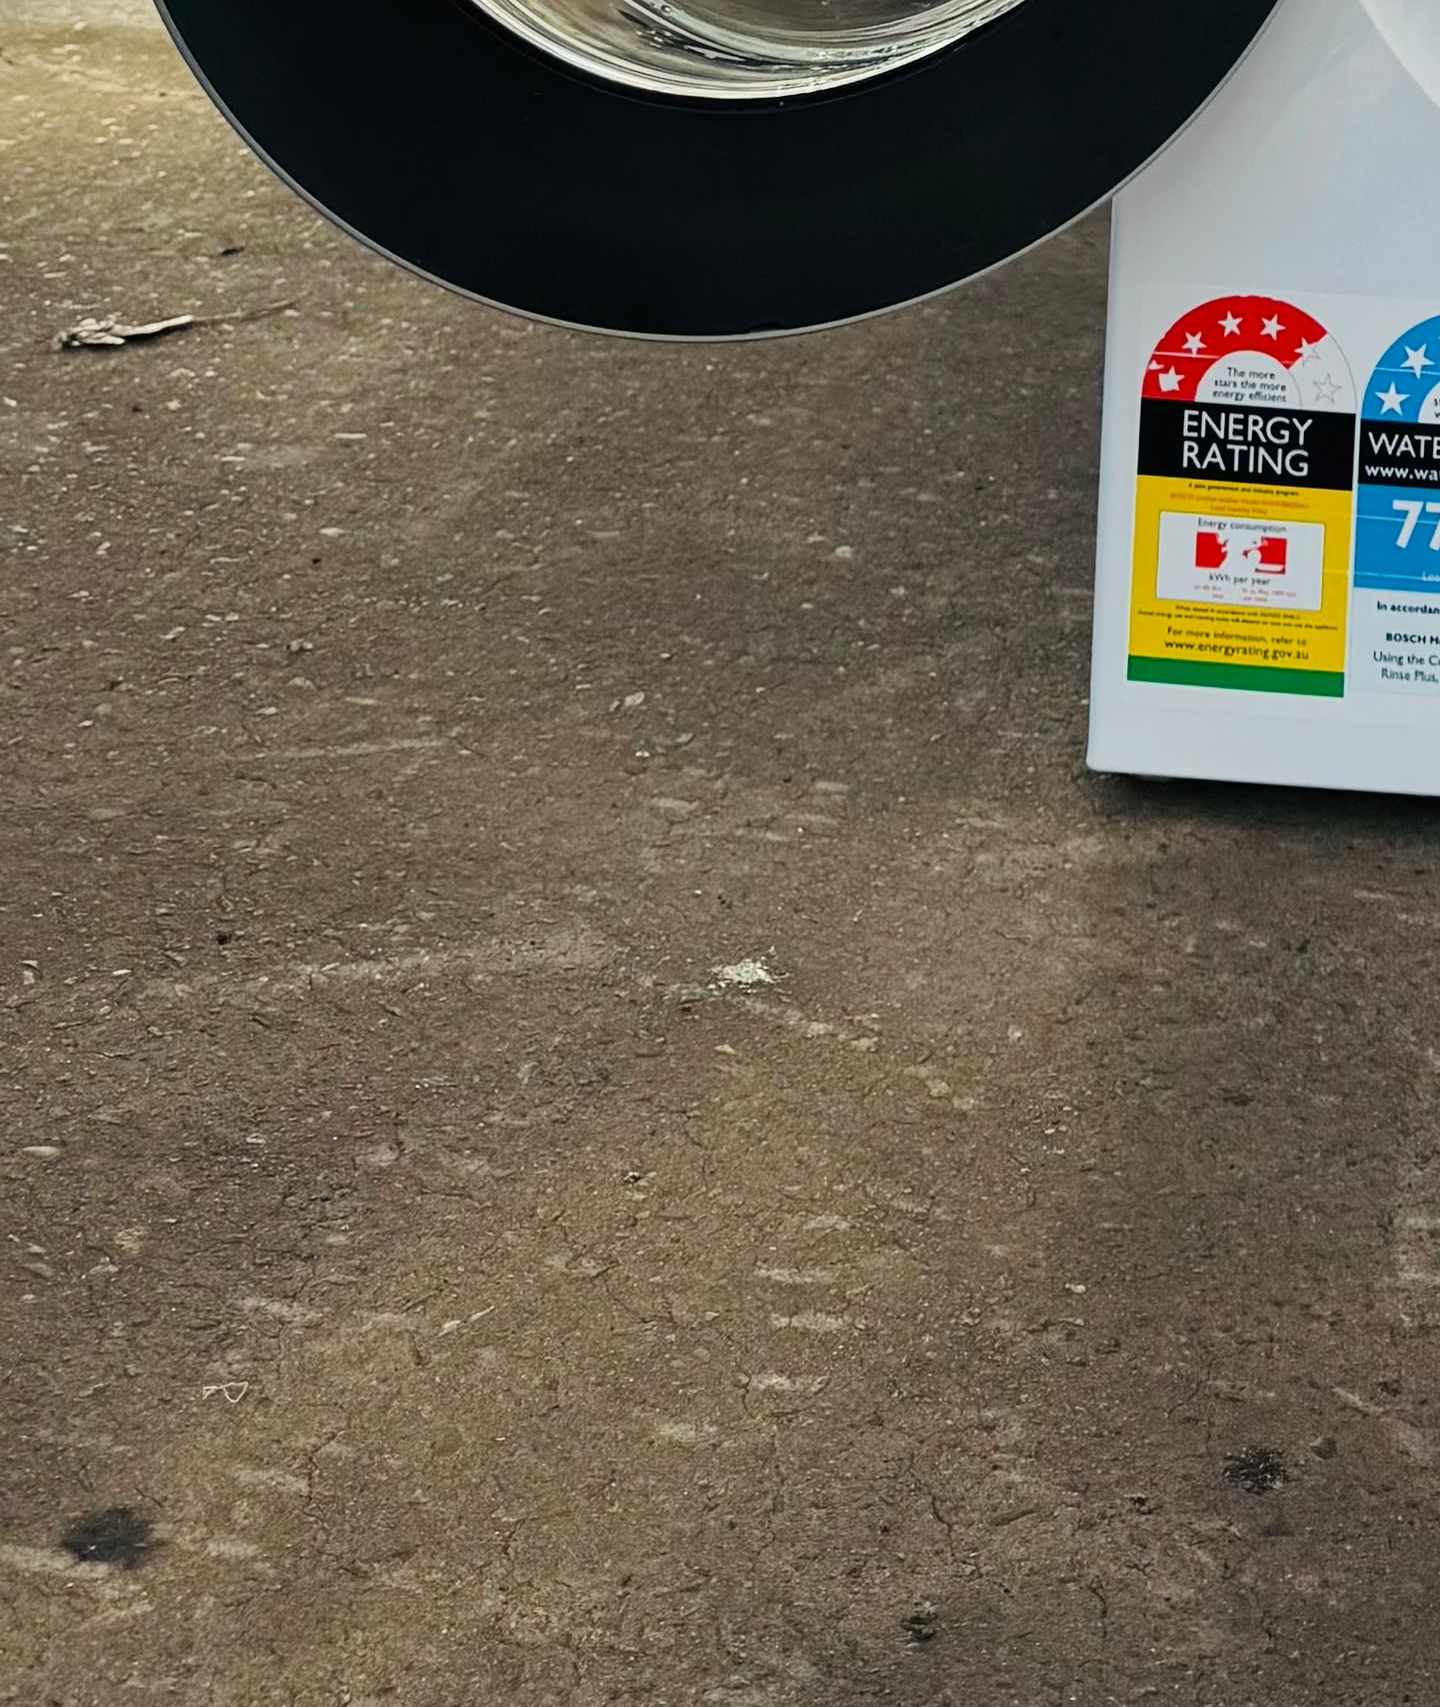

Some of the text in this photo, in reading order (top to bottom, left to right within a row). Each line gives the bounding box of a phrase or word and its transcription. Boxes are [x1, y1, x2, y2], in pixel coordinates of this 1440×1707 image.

[1227, 367, 1275, 380] The more
[1214, 379, 1286, 392] stars the more
[1212, 390, 1287, 403] energy efficient
[1183, 409, 1313, 446] ENERGY
[1182, 440, 1309, 477] RATING
[1198, 517, 1287, 533] Energy consumption
[1233, 576, 1249, 585] per
[1251, 577, 1270, 587] year
[1377, 600, 1387, 611] In
[1167, 626, 1182, 636] For
[1186, 629, 1210, 638] more
[1271, 636, 1293, 645] refer
[1386, 632, 1426, 644] BOSCH
[1164, 639, 1309, 661] www.energyrating.gov.au
[1373, 651, 1404, 666] Using
[1407, 653, 1425, 665] the
[1381, 668, 1410, 681] Rinse
